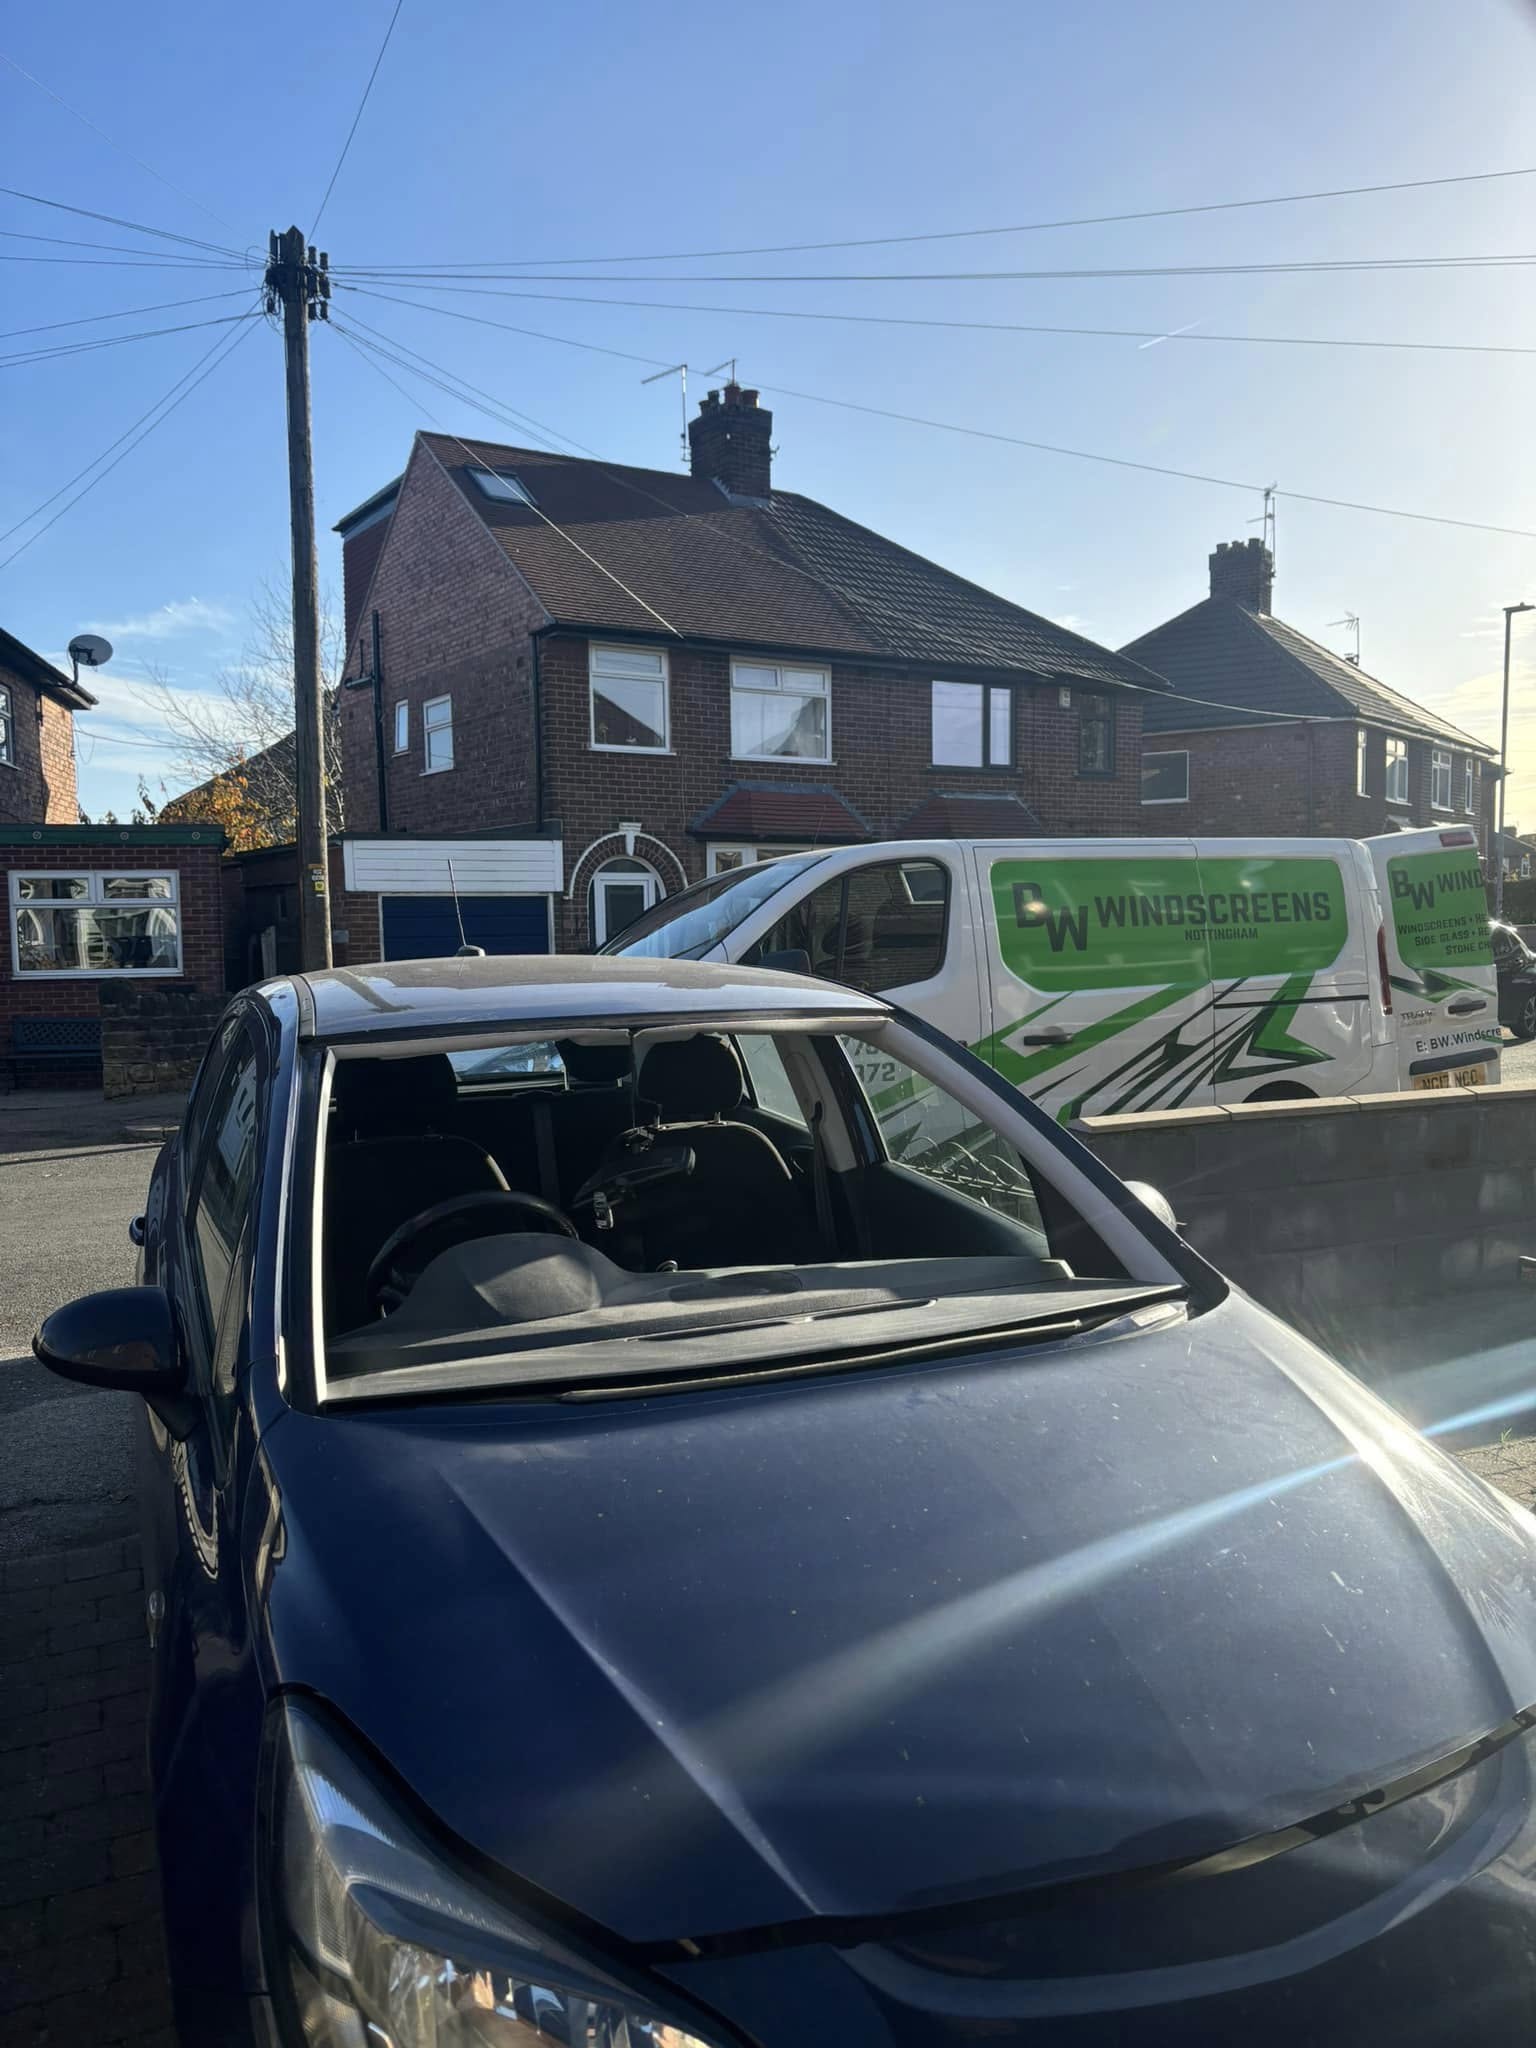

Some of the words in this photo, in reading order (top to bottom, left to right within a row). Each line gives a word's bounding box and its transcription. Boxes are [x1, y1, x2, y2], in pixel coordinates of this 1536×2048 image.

[1094, 891, 1331, 928] WINDSCREENS
[1397, 916, 1467, 935] WINDSCREENS
[1185, 927, 1258, 941] NOTTINGHAM
[1414, 935, 1437, 946] SIDE
[1440, 929, 1470, 942] GLASS
[1446, 942, 1476, 955] STONE
[1416, 1040, 1428, 1053] E:
